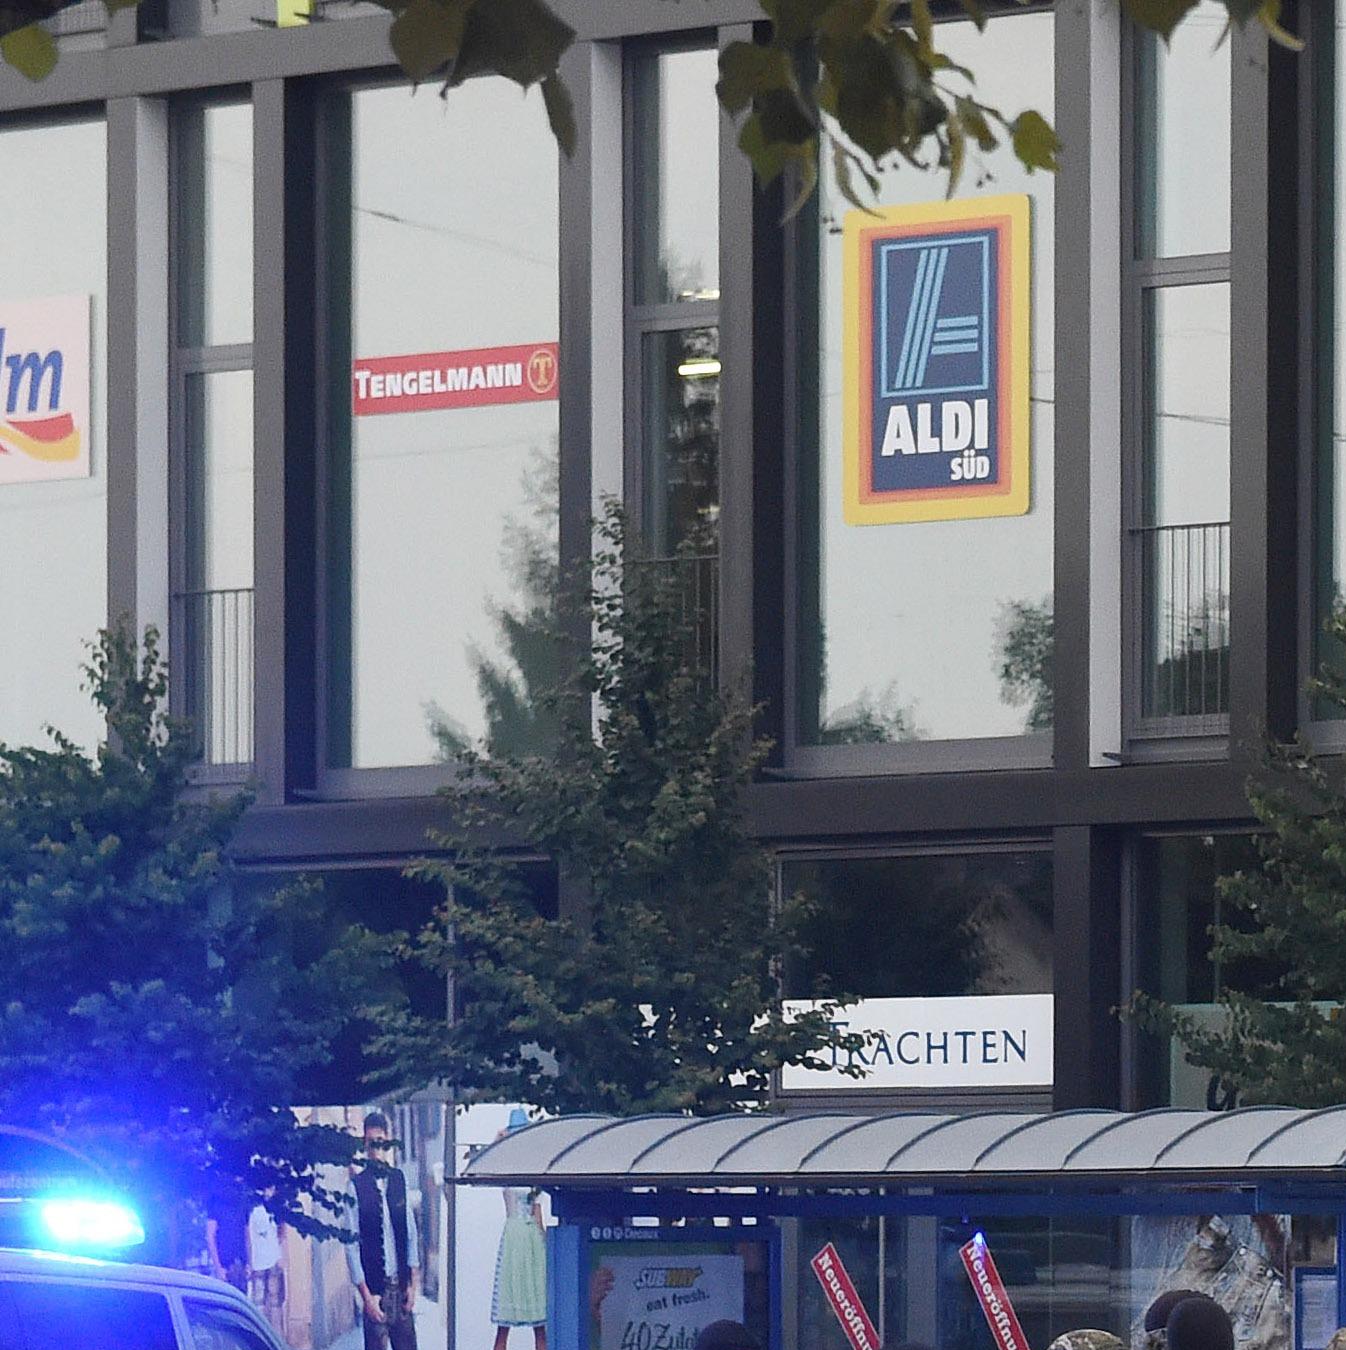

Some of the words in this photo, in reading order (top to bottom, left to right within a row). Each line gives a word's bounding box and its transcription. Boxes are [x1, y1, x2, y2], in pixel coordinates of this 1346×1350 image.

[0, 328, 63, 414] m
[355, 362, 522, 400] TENGELMANN
[881, 398, 988, 457] ALDI
[950, 450, 990, 481] SÜD
